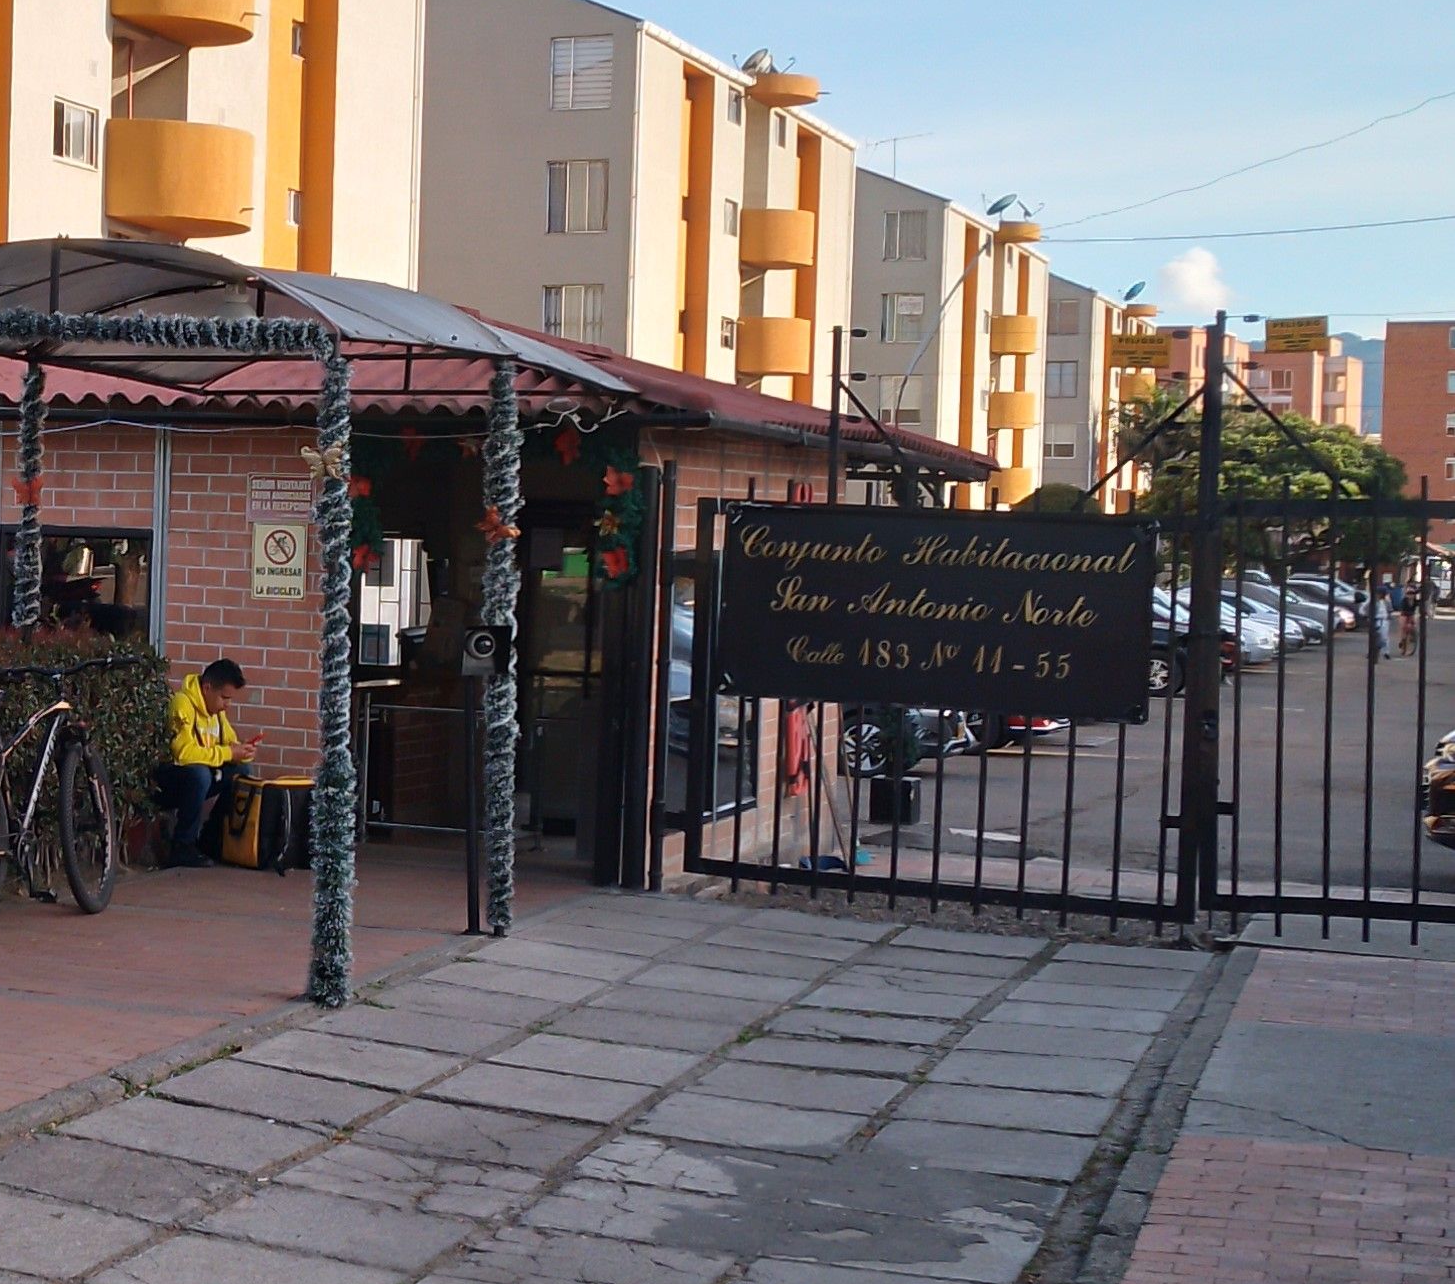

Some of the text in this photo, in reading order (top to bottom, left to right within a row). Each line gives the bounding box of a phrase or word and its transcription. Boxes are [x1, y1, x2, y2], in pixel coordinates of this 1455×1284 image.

[740, 524, 1137, 574] Conjunto Habitacional
[256, 567, 302, 577] NO INGRESAR
[255, 586, 302, 596] LA BICICLETA
[770, 576, 1099, 628] San Antonio Norte
[787, 635, 845, 665] Calle
[858, 637, 910, 669] 183
